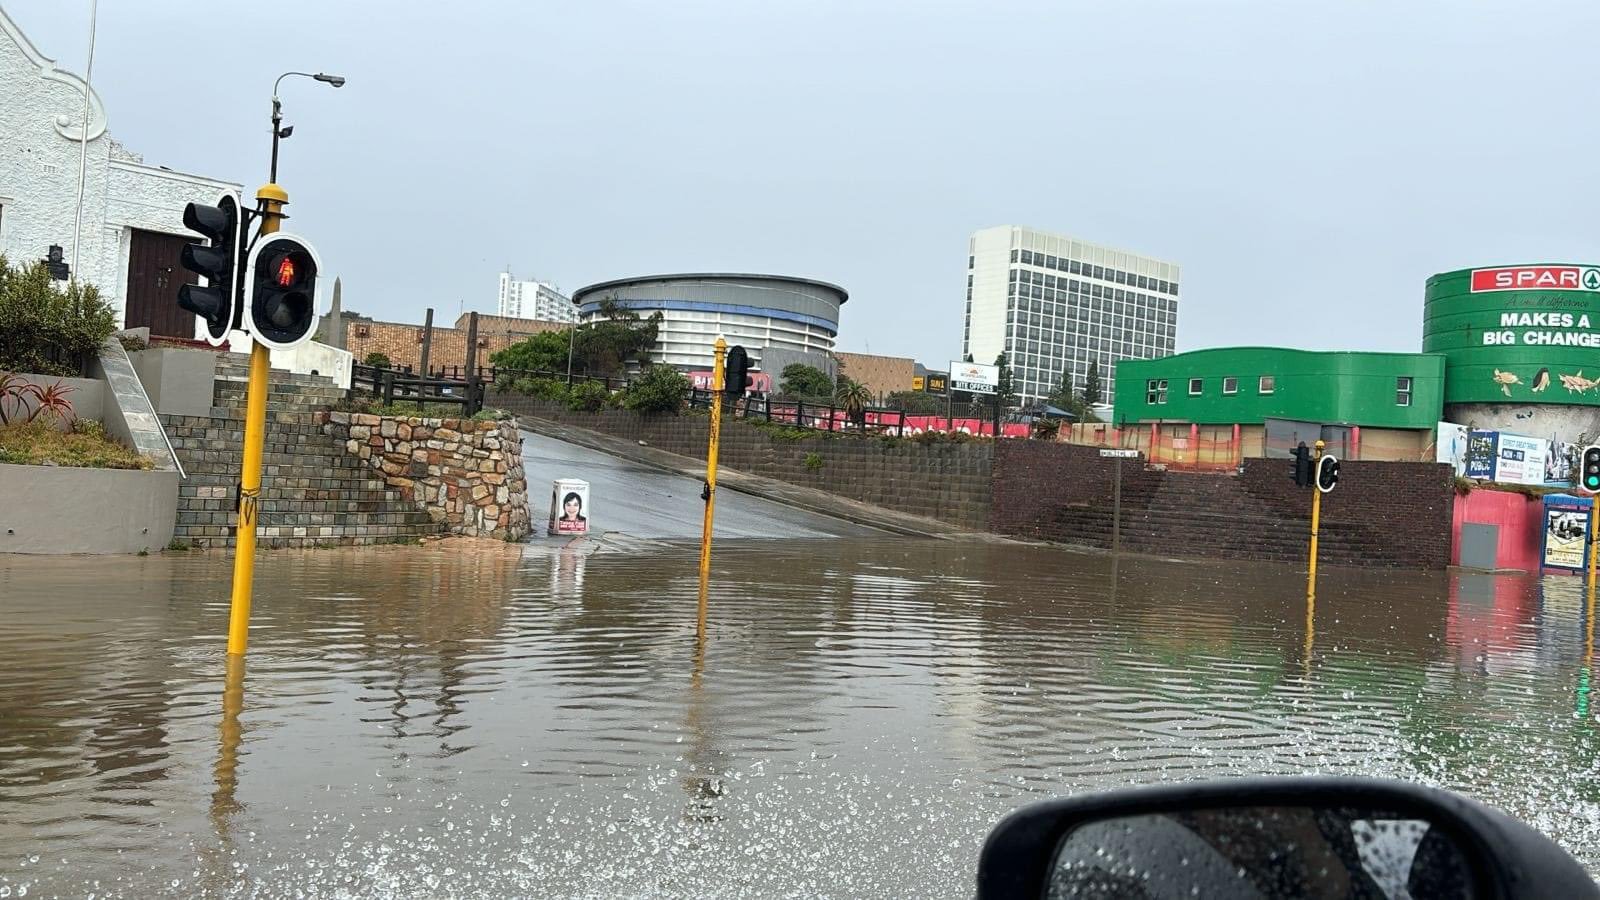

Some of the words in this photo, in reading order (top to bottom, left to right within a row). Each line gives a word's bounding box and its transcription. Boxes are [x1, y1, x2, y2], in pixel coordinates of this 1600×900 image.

[1495, 271, 1578, 287] SPAR
[1545, 296, 1590, 312] difference
[1500, 313, 1574, 328] MAKES
[1577, 315, 1591, 328] A
[1483, 331, 1516, 345] BIG
[1522, 332, 1600, 347] CHANGE
[956, 381, 969, 390] SITE
[969, 382, 994, 392] OFFICES
